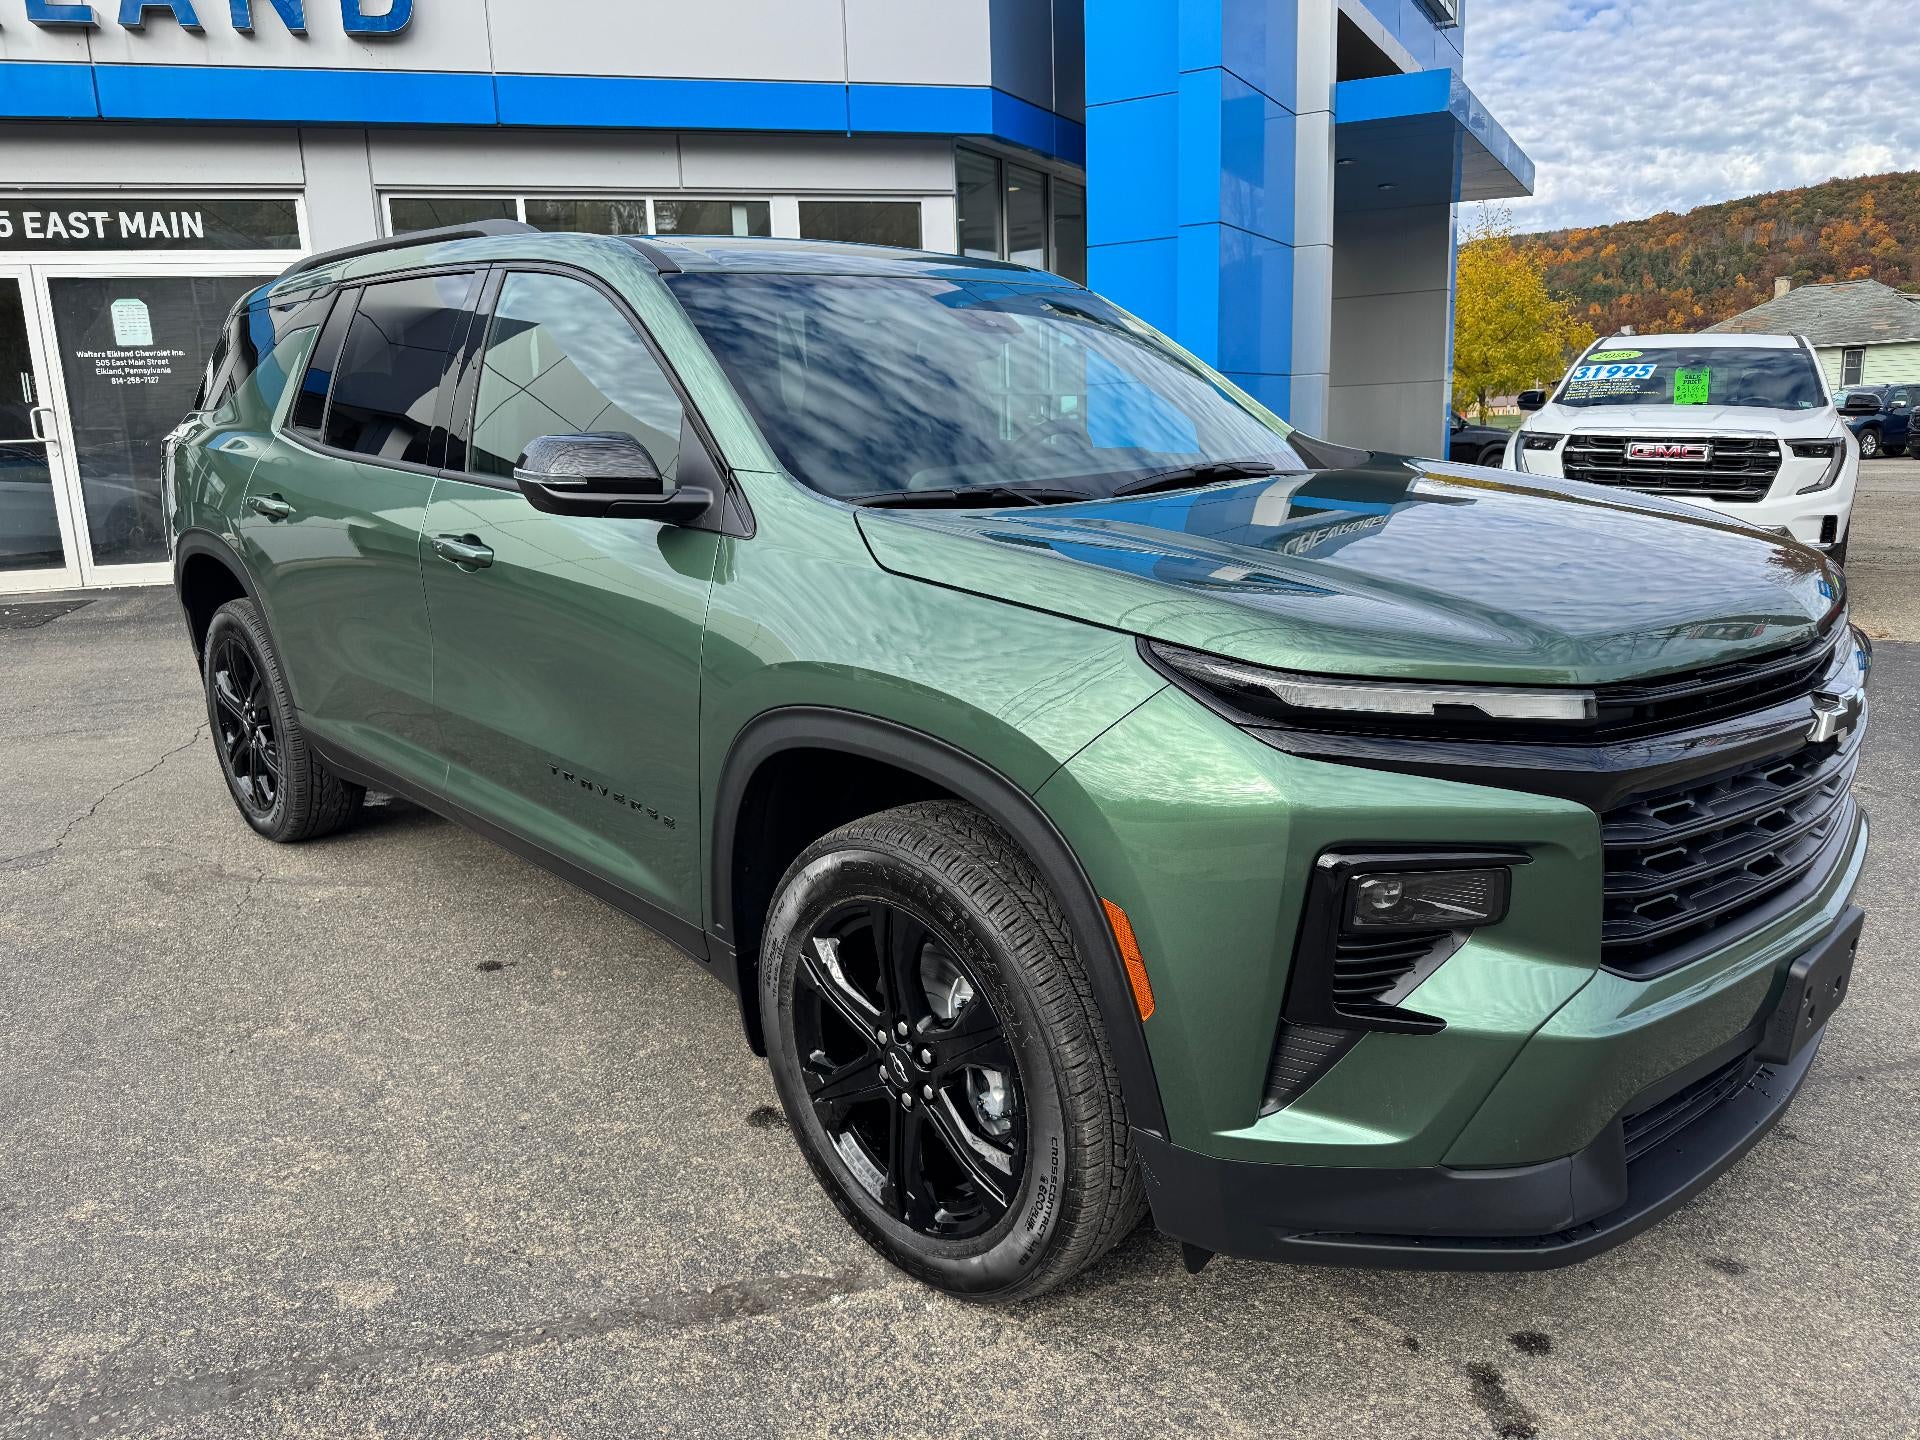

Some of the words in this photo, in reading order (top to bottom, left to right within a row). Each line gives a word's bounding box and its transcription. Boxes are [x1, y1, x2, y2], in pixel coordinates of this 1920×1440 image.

[23, 211, 109, 239] EAST
[118, 211, 204, 238] MAIN
[75, 350, 106, 358] Walters
[107, 350, 134, 358] Elkland
[95, 359, 111, 367] 505
[95, 368, 125, 376] Elkland,
[125, 367, 171, 375] Pennsylvania
[111, 376, 159, 385] 814-258-7127
[1632, 445, 1706, 459] GMC
[547, 762, 677, 830] TRAVERSE
